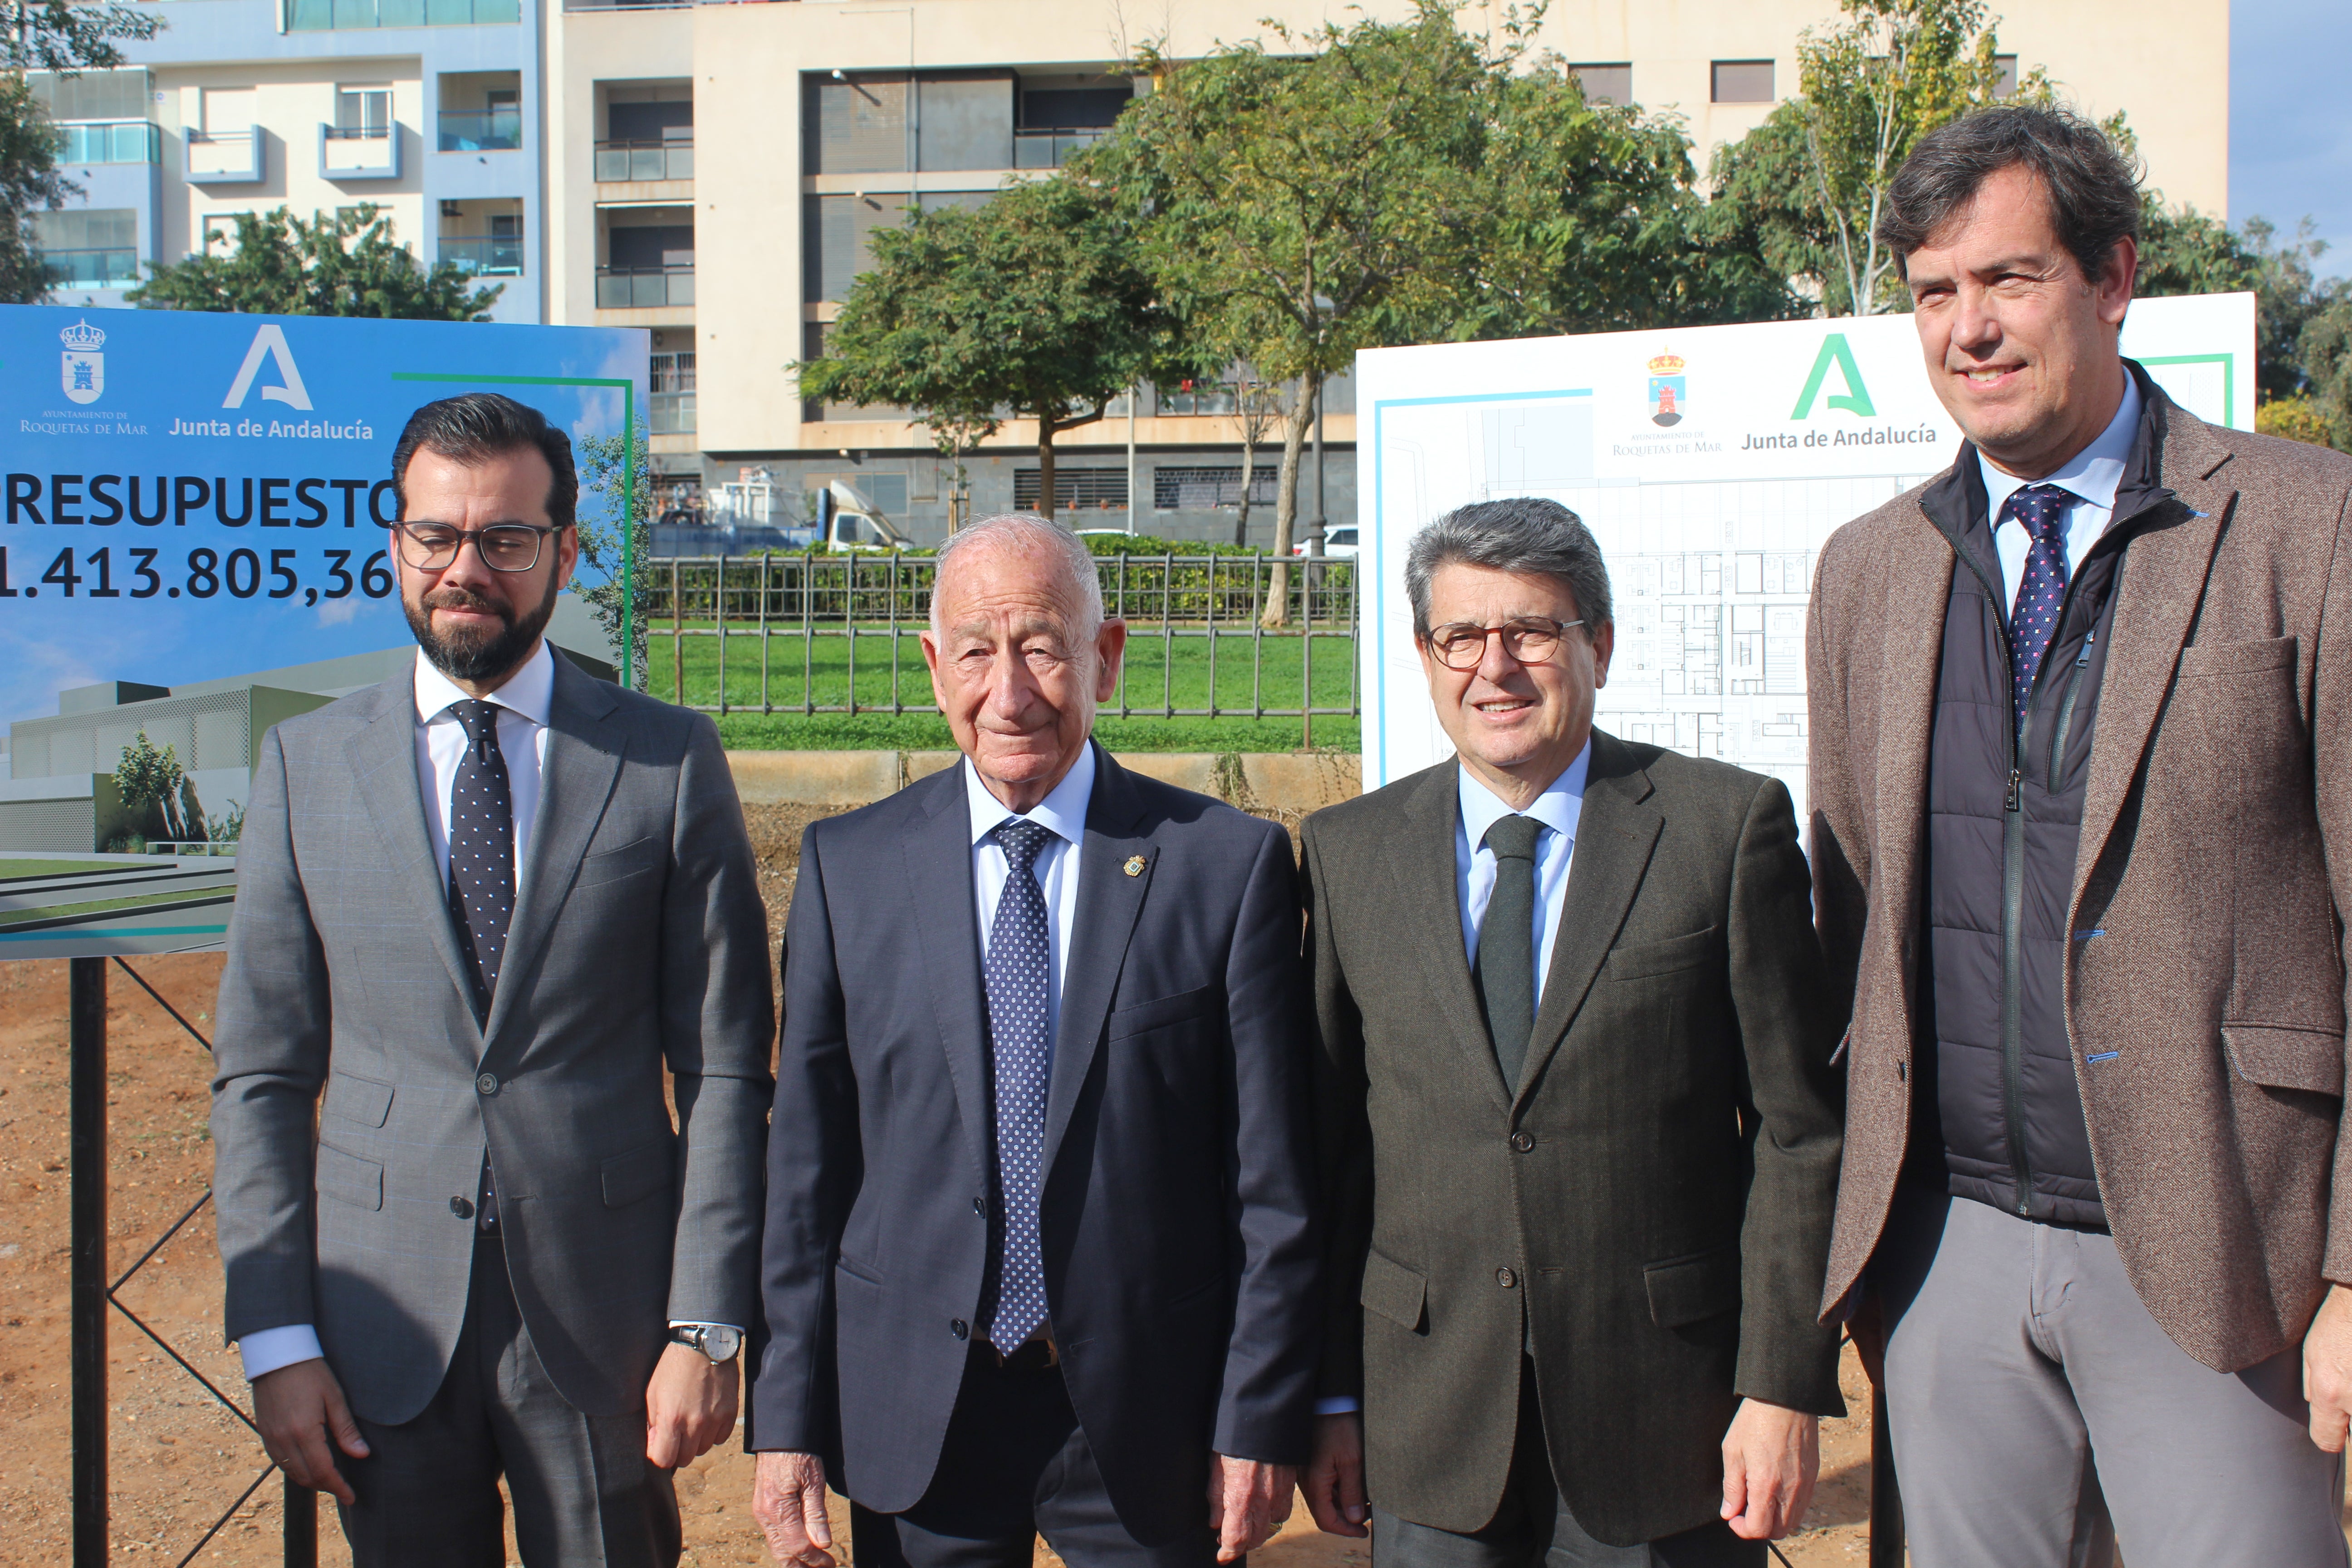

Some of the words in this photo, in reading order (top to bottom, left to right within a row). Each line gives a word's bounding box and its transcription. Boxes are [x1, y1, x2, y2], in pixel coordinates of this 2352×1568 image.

[42, 410, 114, 419] AYUNTAMIENTO
[95, 424, 111, 434] DE
[169, 418, 230, 436] Junta
[237, 419, 263, 437] de
[268, 419, 373, 440] Andalucía
[1631, 432, 1692, 441] AYUNTAMIENTO
[1741, 433, 1798, 450] Junta
[1803, 429, 1828, 447] de
[1833, 422, 1936, 446] Andalucía
[1676, 444, 1690, 453] DE
